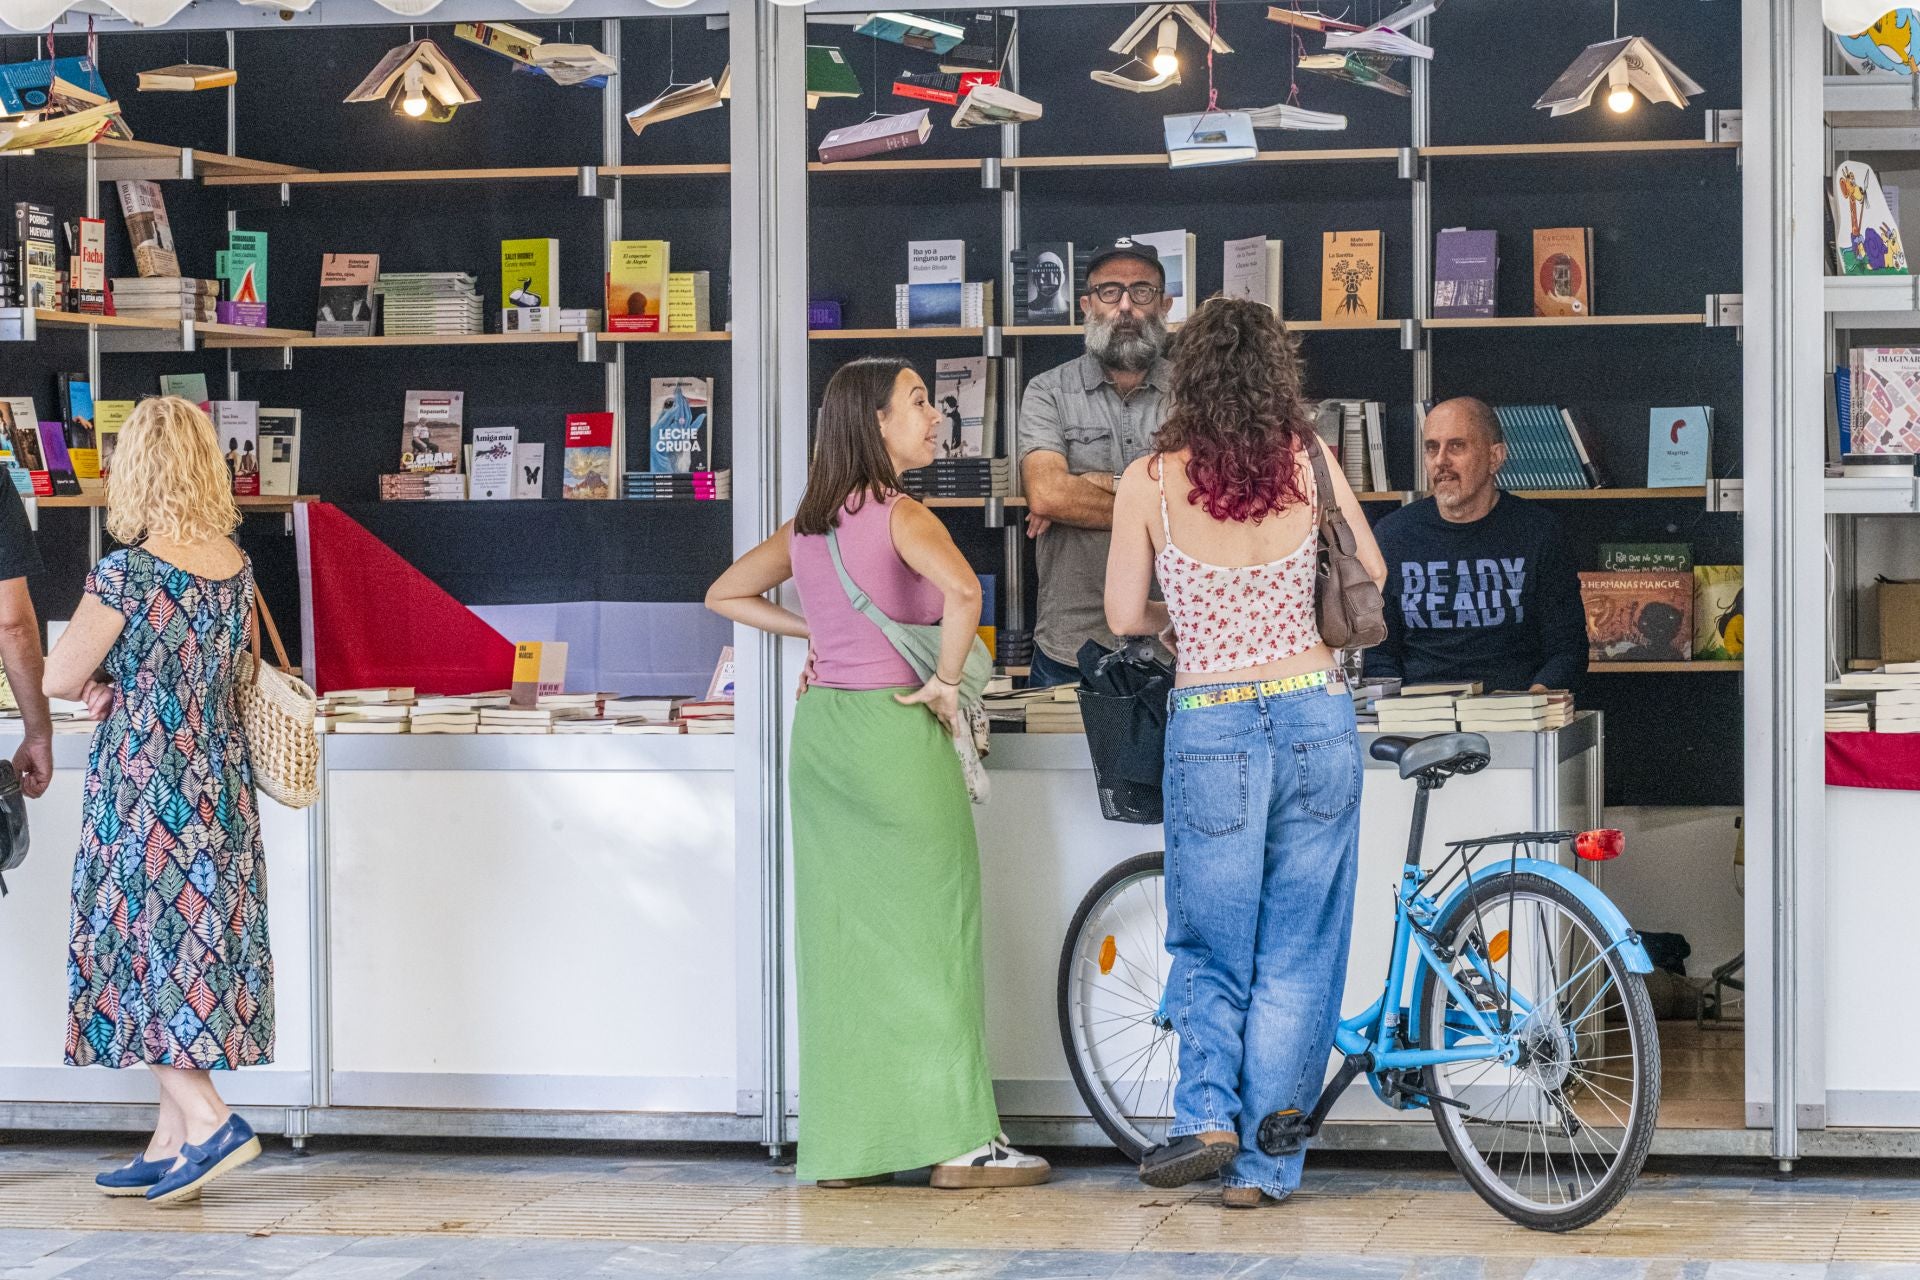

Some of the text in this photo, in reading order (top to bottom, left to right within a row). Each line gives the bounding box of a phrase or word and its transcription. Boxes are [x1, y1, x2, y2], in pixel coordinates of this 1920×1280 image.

[83, 247, 104, 264] Facha
[476, 434, 497, 442] Amiga
[659, 428, 698, 440] LECHE
[656, 440, 701, 452] CRUDA
[1588, 580, 1638, 589] HERMANAS
[1640, 580, 1680, 589] MANGUE
